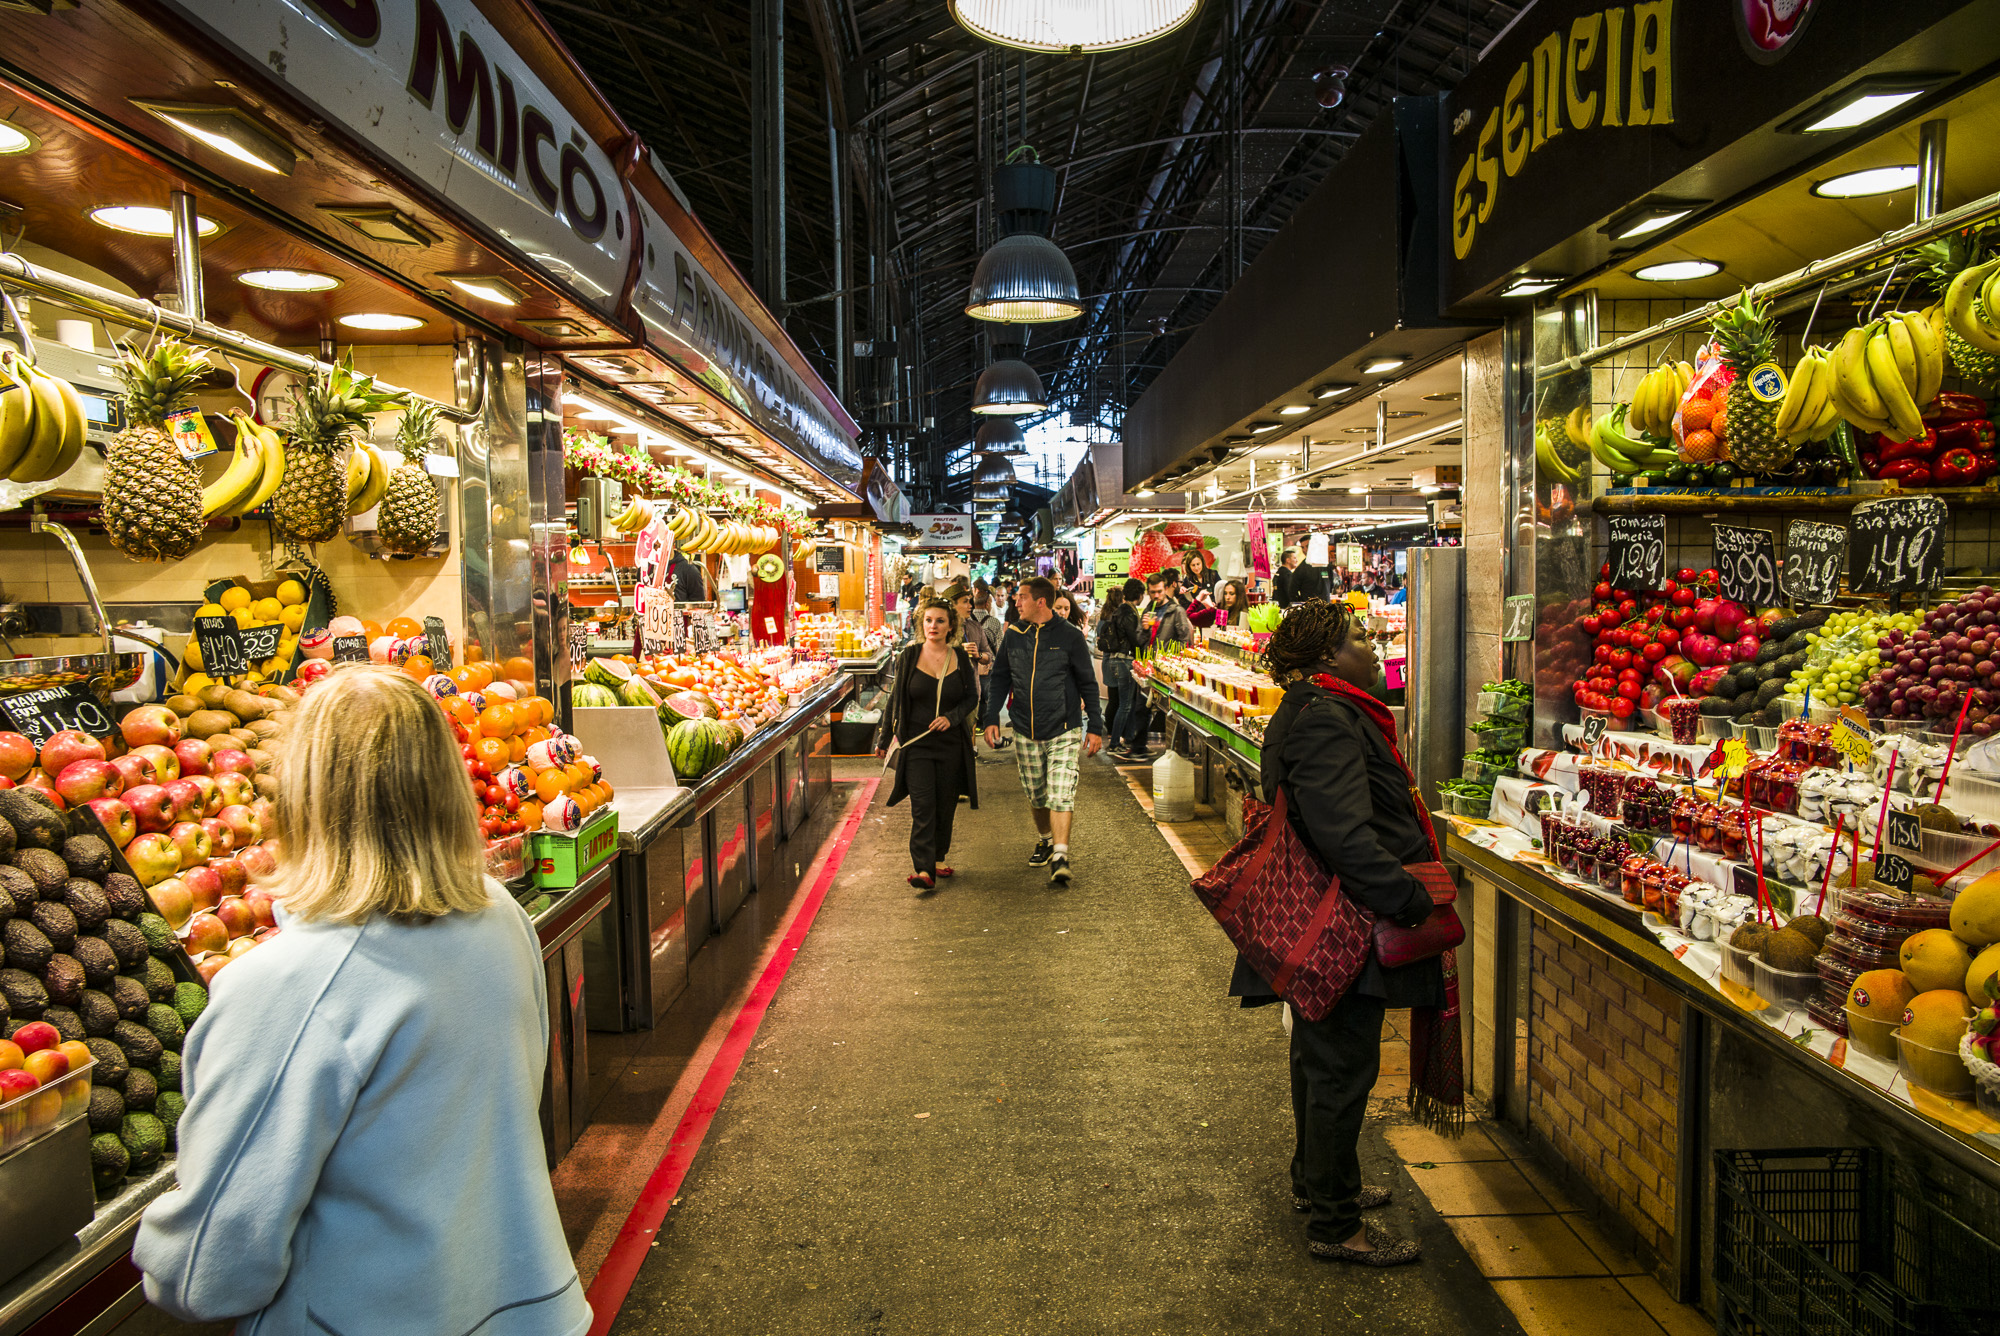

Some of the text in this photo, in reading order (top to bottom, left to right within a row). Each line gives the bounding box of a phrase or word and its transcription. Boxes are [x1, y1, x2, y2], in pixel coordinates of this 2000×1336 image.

[408, 0, 608, 243] MICÓ
[4, 686, 71, 709] MANZANA
[1585, 720, 1597, 742] 2
[1843, 717, 1870, 742] OFERTA
[588, 826, 614, 860] SALVI
